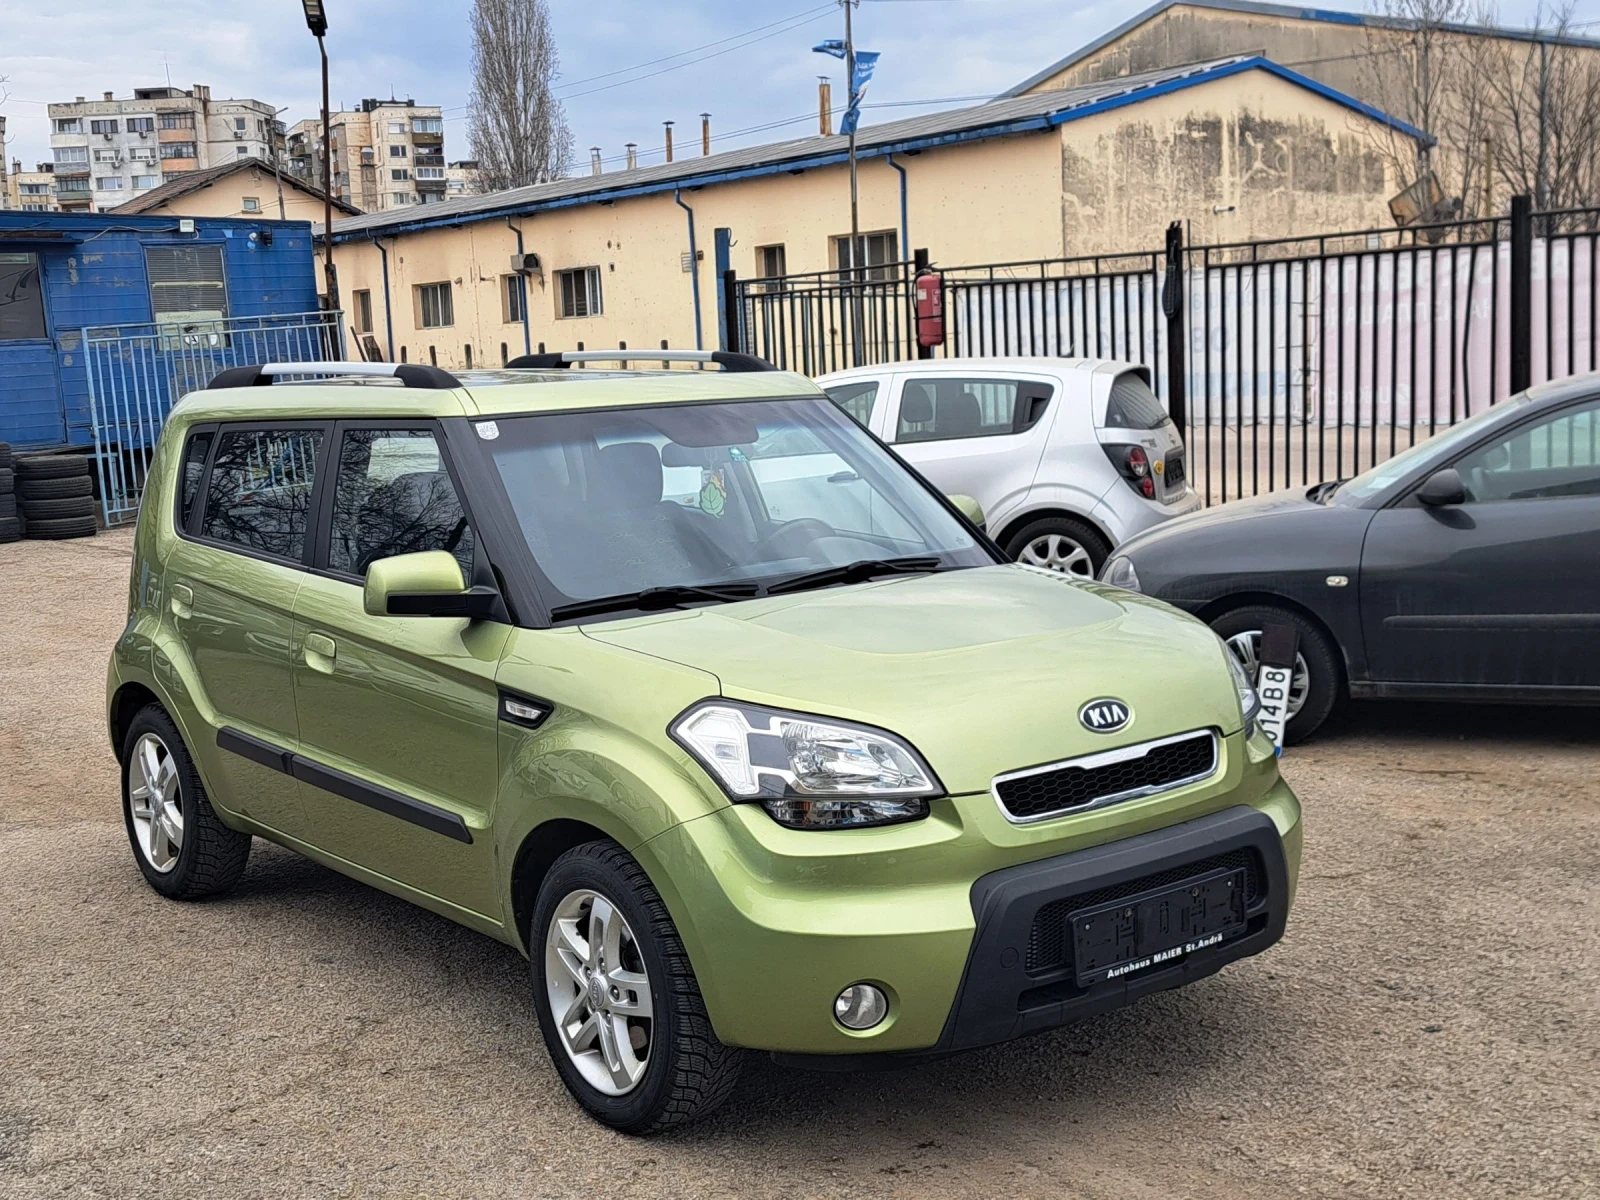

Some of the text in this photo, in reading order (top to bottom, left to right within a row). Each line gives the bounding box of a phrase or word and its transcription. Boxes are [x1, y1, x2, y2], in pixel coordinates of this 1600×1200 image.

[1087, 704, 1126, 727] KIA
[1107, 958, 1150, 979] Autohaus
[1153, 947, 1182, 963] MAIER
